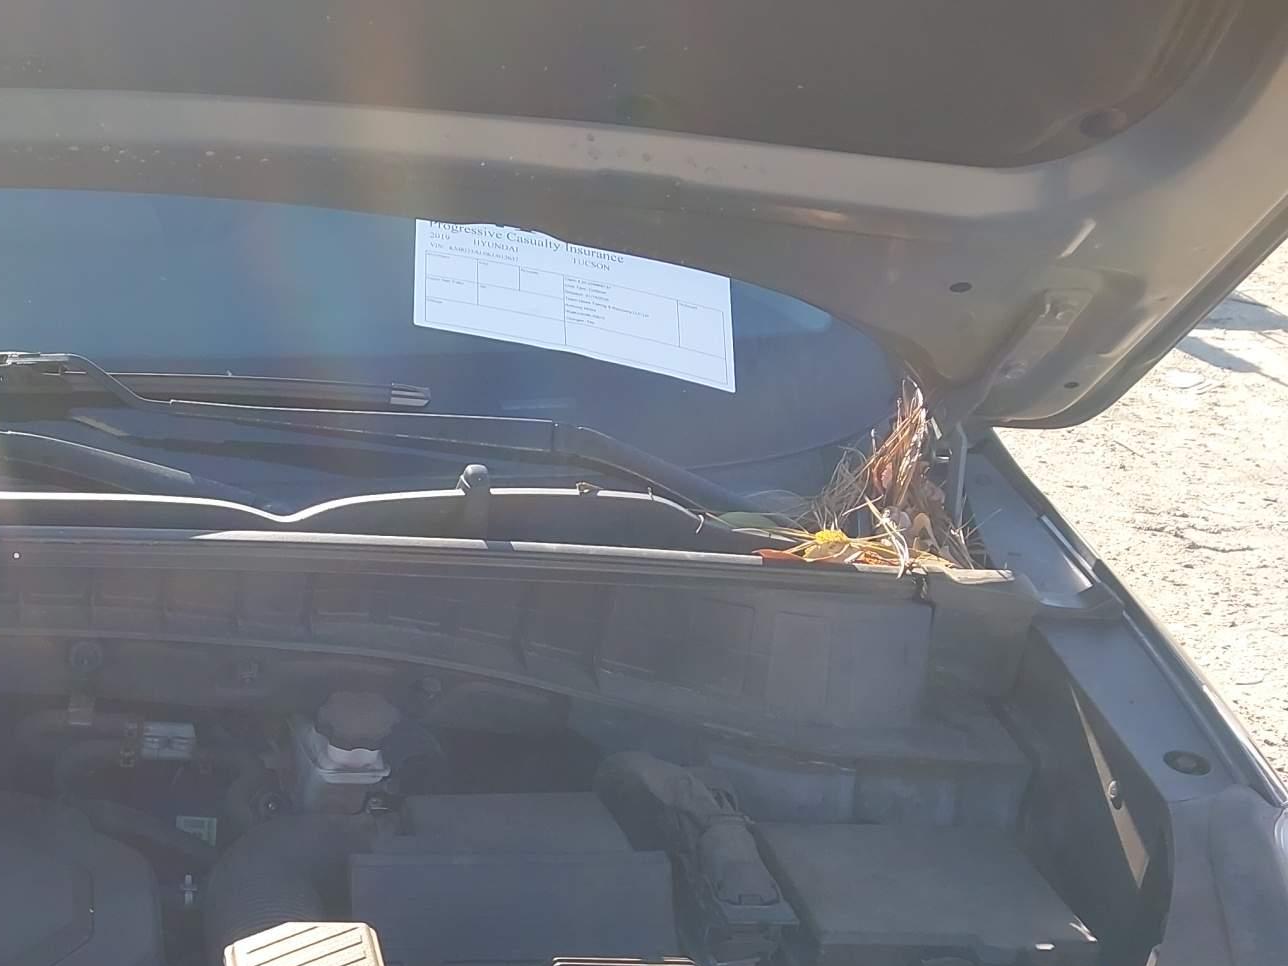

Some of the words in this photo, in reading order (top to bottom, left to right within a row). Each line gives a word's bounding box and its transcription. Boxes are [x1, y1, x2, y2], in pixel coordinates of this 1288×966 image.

[429, 232, 451, 241] 2019
[473, 238, 520, 253] HYUNDAI
[572, 257, 611, 272] TUCSON
[506, 231, 561, 253] Casualty
[565, 242, 625, 264] Insurance
